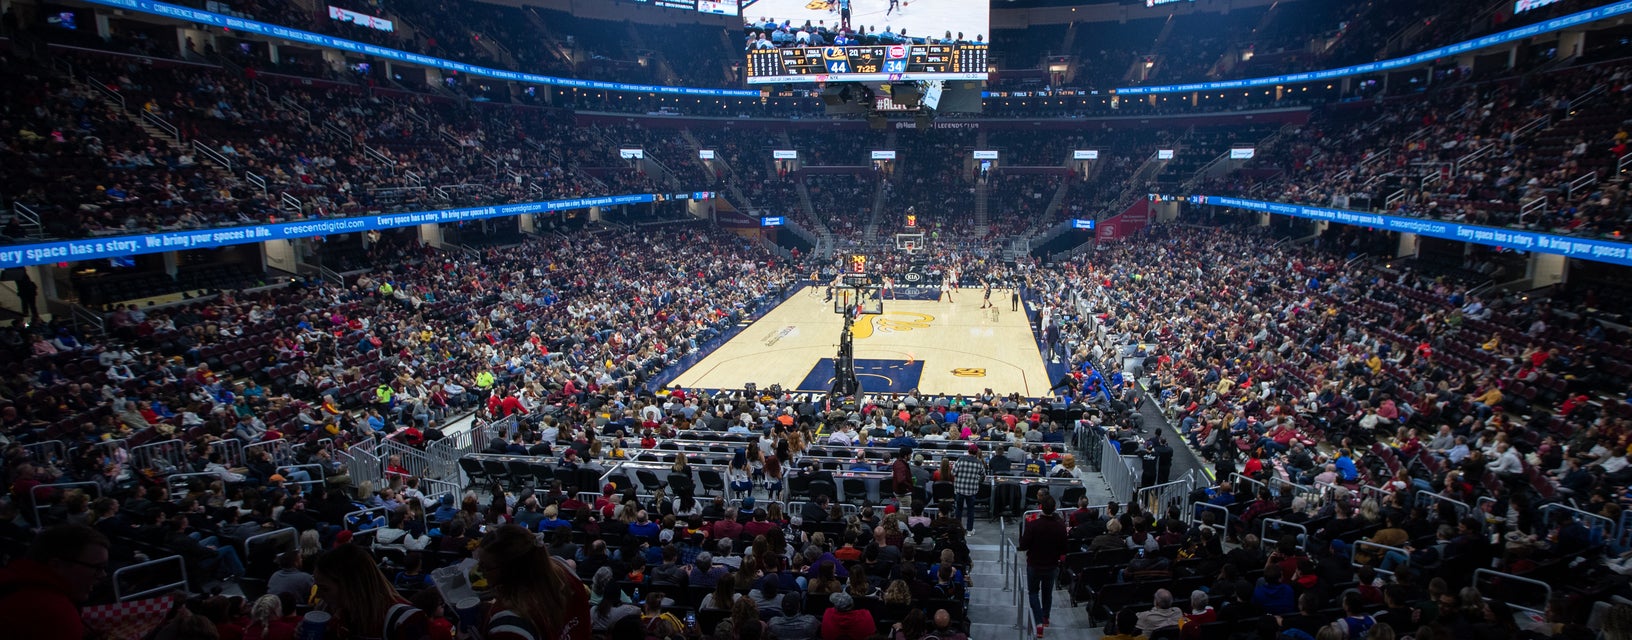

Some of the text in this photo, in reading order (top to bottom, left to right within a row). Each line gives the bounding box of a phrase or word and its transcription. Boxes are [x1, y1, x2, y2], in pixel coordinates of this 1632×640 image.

[830, 61, 846, 73] 44
[856, 65, 877, 73] 7:25
[887, 60, 903, 72] 34
[377, 216, 393, 226] Every
[394, 215, 410, 226] space
[410, 213, 420, 222] has
[425, 213, 440, 222] story.
[283, 219, 365, 235] crescentdigital.com
[26, 246, 67, 262] space
[69, 243, 93, 255] has
[95, 243, 104, 252] a
[106, 239, 141, 252] story.
[145, 236, 161, 247] We
[163, 233, 189, 247] bring
[190, 234, 211, 246] your
[213, 229, 244, 243] spaces
[245, 228, 255, 238] to
[255, 226, 272, 237] life.
[1457, 226, 1474, 240] Every
[1549, 237, 1571, 254] bring
[854, 262, 864, 273] 13
